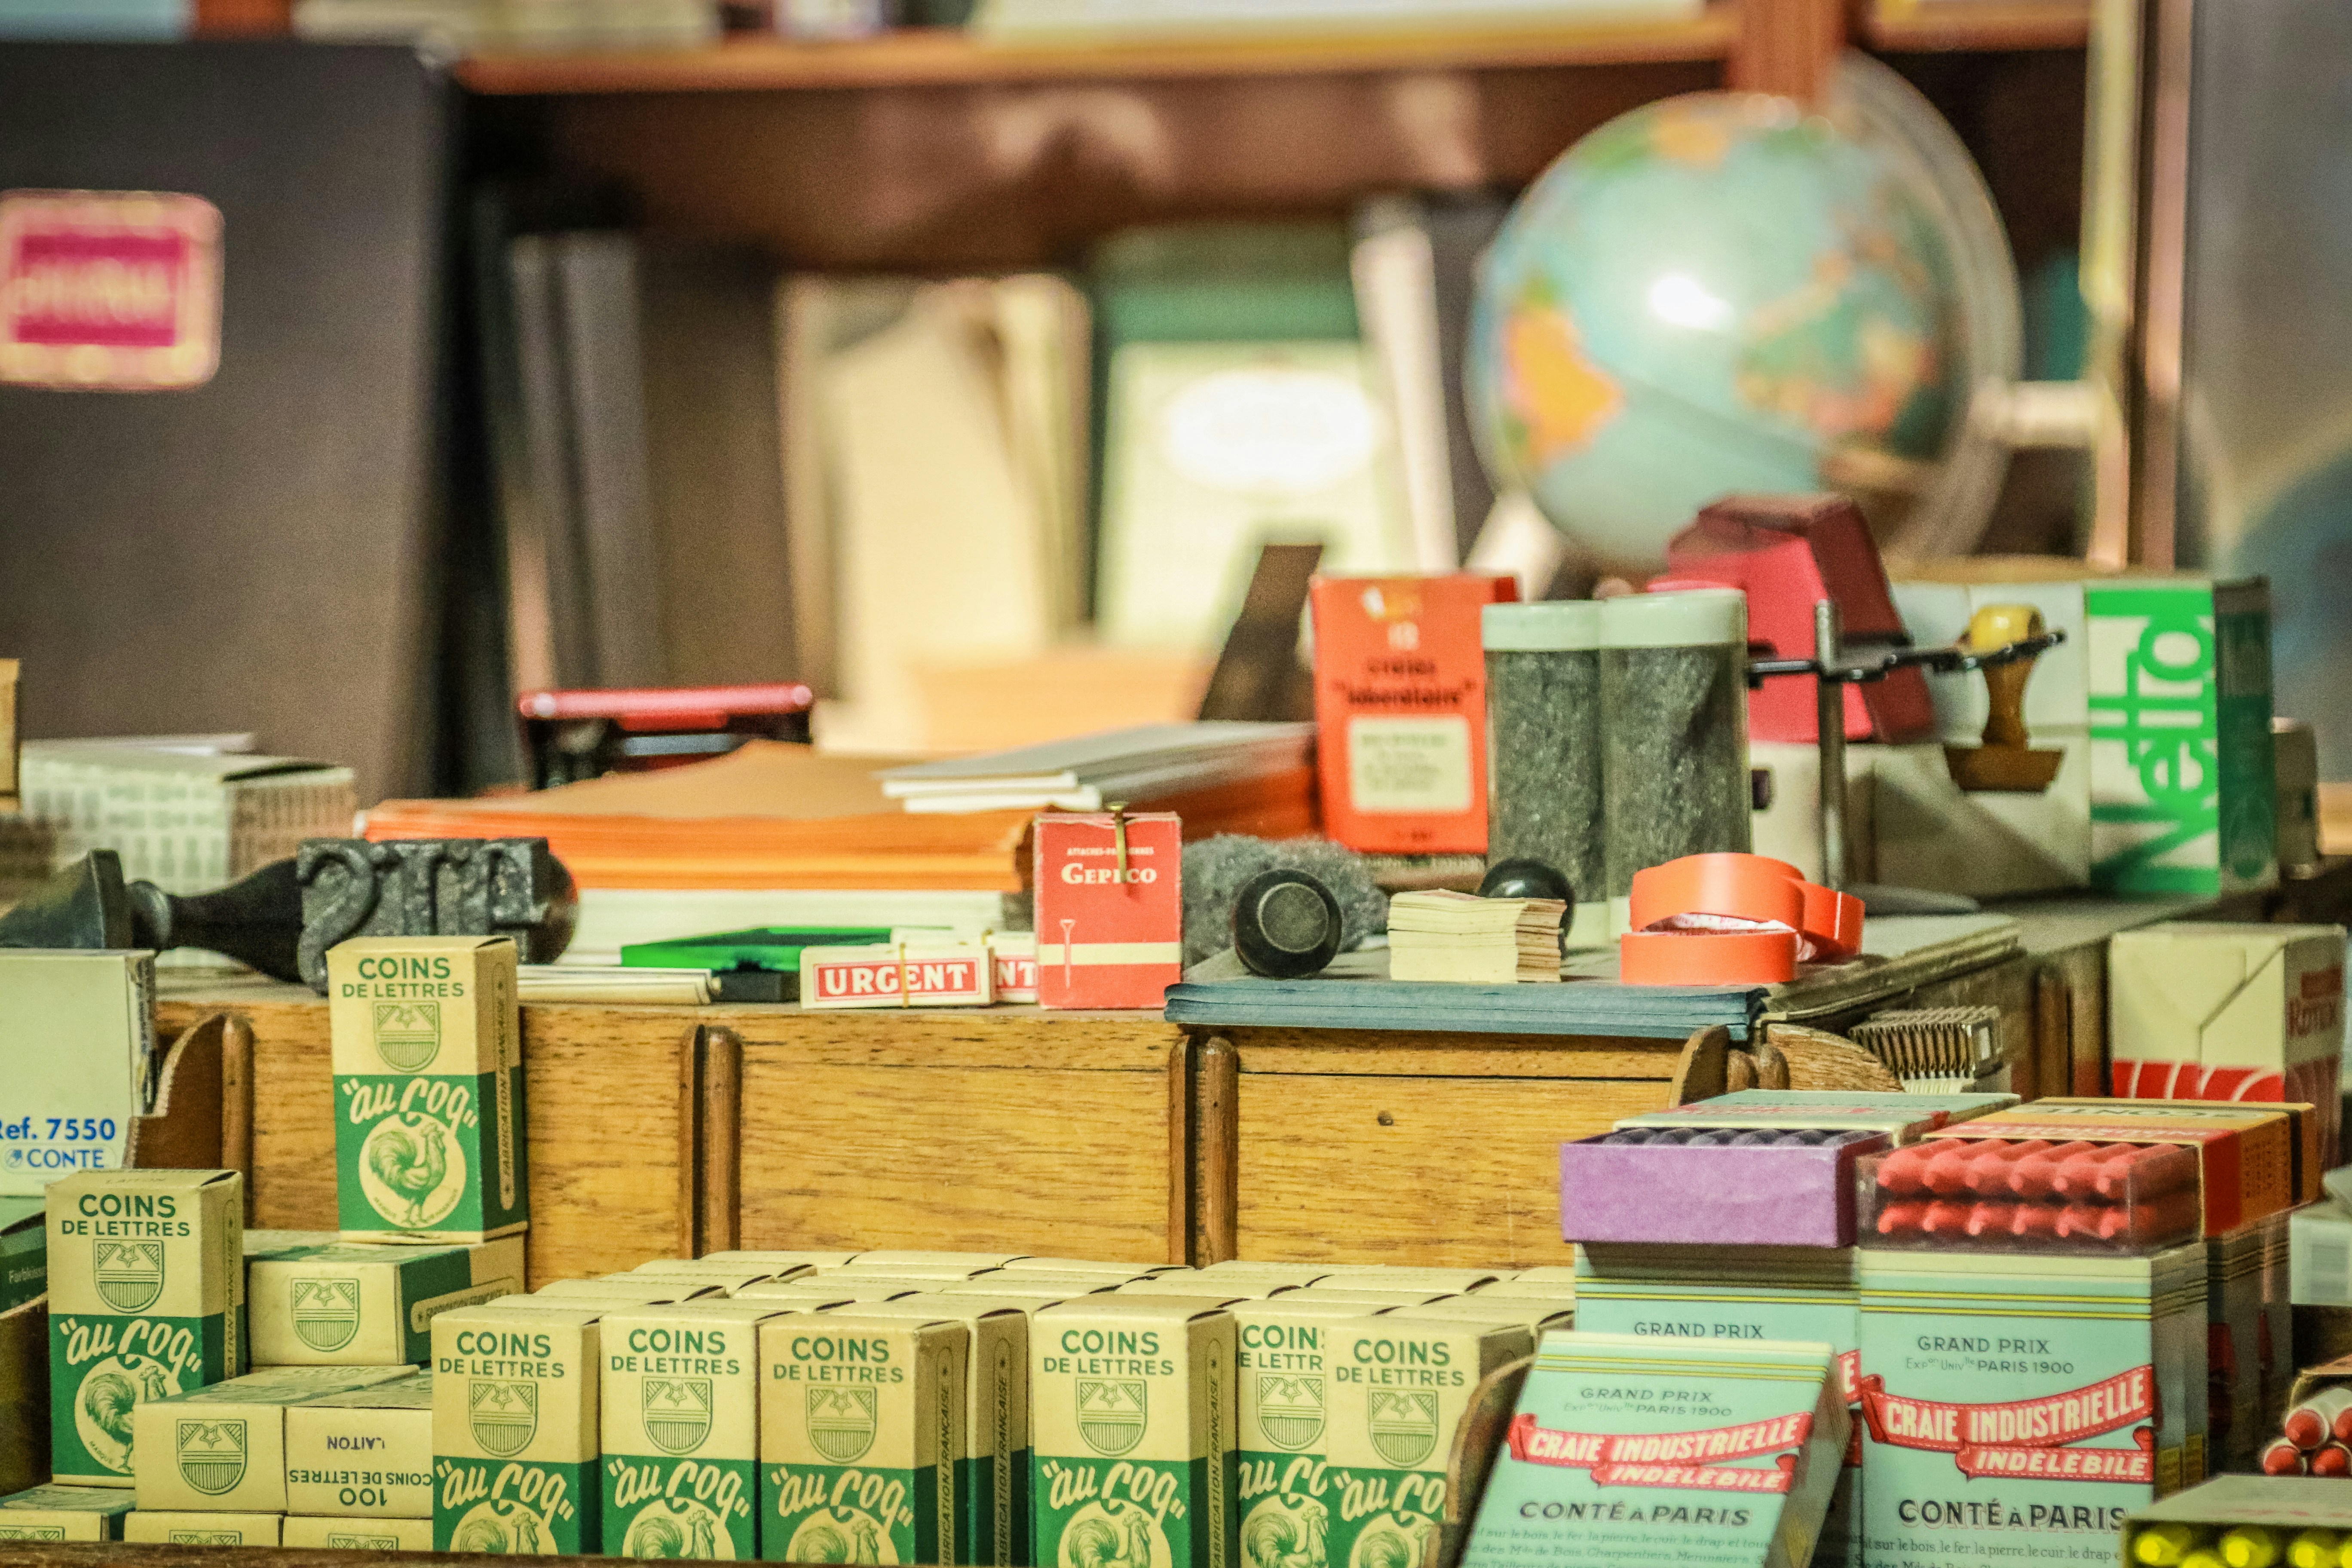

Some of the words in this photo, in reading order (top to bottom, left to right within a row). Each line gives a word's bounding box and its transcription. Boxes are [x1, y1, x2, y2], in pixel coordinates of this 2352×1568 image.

[359, 957, 450, 980] COINS
[824, 963, 968, 995] URGENT
[343, 983, 368, 998] DE
[375, 983, 464, 998] LETTRES
[0, 1116, 37, 1140] ef.
[46, 1118, 116, 1141] 7550
[27, 1148, 104, 1168] CONTE
[79, 1194, 176, 1218] COINS
[61, 1220, 88, 1235] DE
[95, 1221, 190, 1237] LETTRES
[1243, 1325, 1325, 1350] COIN
[1634, 1322, 1706, 1337] GRAND
[1714, 1324, 1765, 1339] PRIX
[456, 1331, 551, 1358] COINS
[629, 1329, 726, 1355] COINS
[791, 1337, 890, 1363] COINS
[1061, 1330, 1160, 1356] COINS
[1354, 1338, 1451, 1366] COINS
[1918, 1335, 1991, 1353] GRAND
[1997, 1338, 2052, 1354] PRIX
[439, 1358, 465, 1375] DE
[472, 1360, 565, 1378] LETTRES
[611, 1356, 637, 1372] DE
[644, 1357, 740, 1375] LETTRES
[1043, 1357, 1071, 1373] DE
[1078, 1358, 1174, 1376] LETTRES
[1259, 1353, 1323, 1371] LETTR
[1978, 1359, 2029, 1373] PARIS
[2033, 1361, 2074, 1374] 1900
[774, 1364, 801, 1381] DE
[808, 1365, 903, 1383] LETTRES
[1336, 1366, 1363, 1383] DE
[1369, 1369, 1465, 1387] LETTRES
[1580, 1388, 1654, 1400] GRAND
[1661, 1390, 1714, 1403] PRIX
[998, 1375, 1008, 1461] FRANÇAISE
[1636, 1404, 1687, 1415] PARIS
[1692, 1407, 1732, 1417] 1900
[1887, 1401, 1958, 1442] CRAIE
[1970, 1373, 2145, 1443] INDUSTRIELLE
[1529, 1433, 1605, 1462] CRAIE
[1612, 1416, 1800, 1462] INDUSTRIELLE
[289, 1470, 358, 1485] LETTRES
[361, 1472, 382, 1485] DE
[386, 1472, 432, 1486] COINS
[339, 1488, 387, 1507] 100
[1519, 1501, 1626, 1521] CONTÉ
[1651, 1505, 1752, 1527] PARIS
[1899, 1498, 2003, 1527] CONTÉ
[2029, 1504, 2127, 1531] PARIS
[1898, 1538, 1908, 1551] le
[1940, 1540, 1952, 1553] le
[2027, 1544, 2039, 1557] le
[2069, 1546, 2079, 1559] le
[2082, 1547, 2111, 1563] drap
